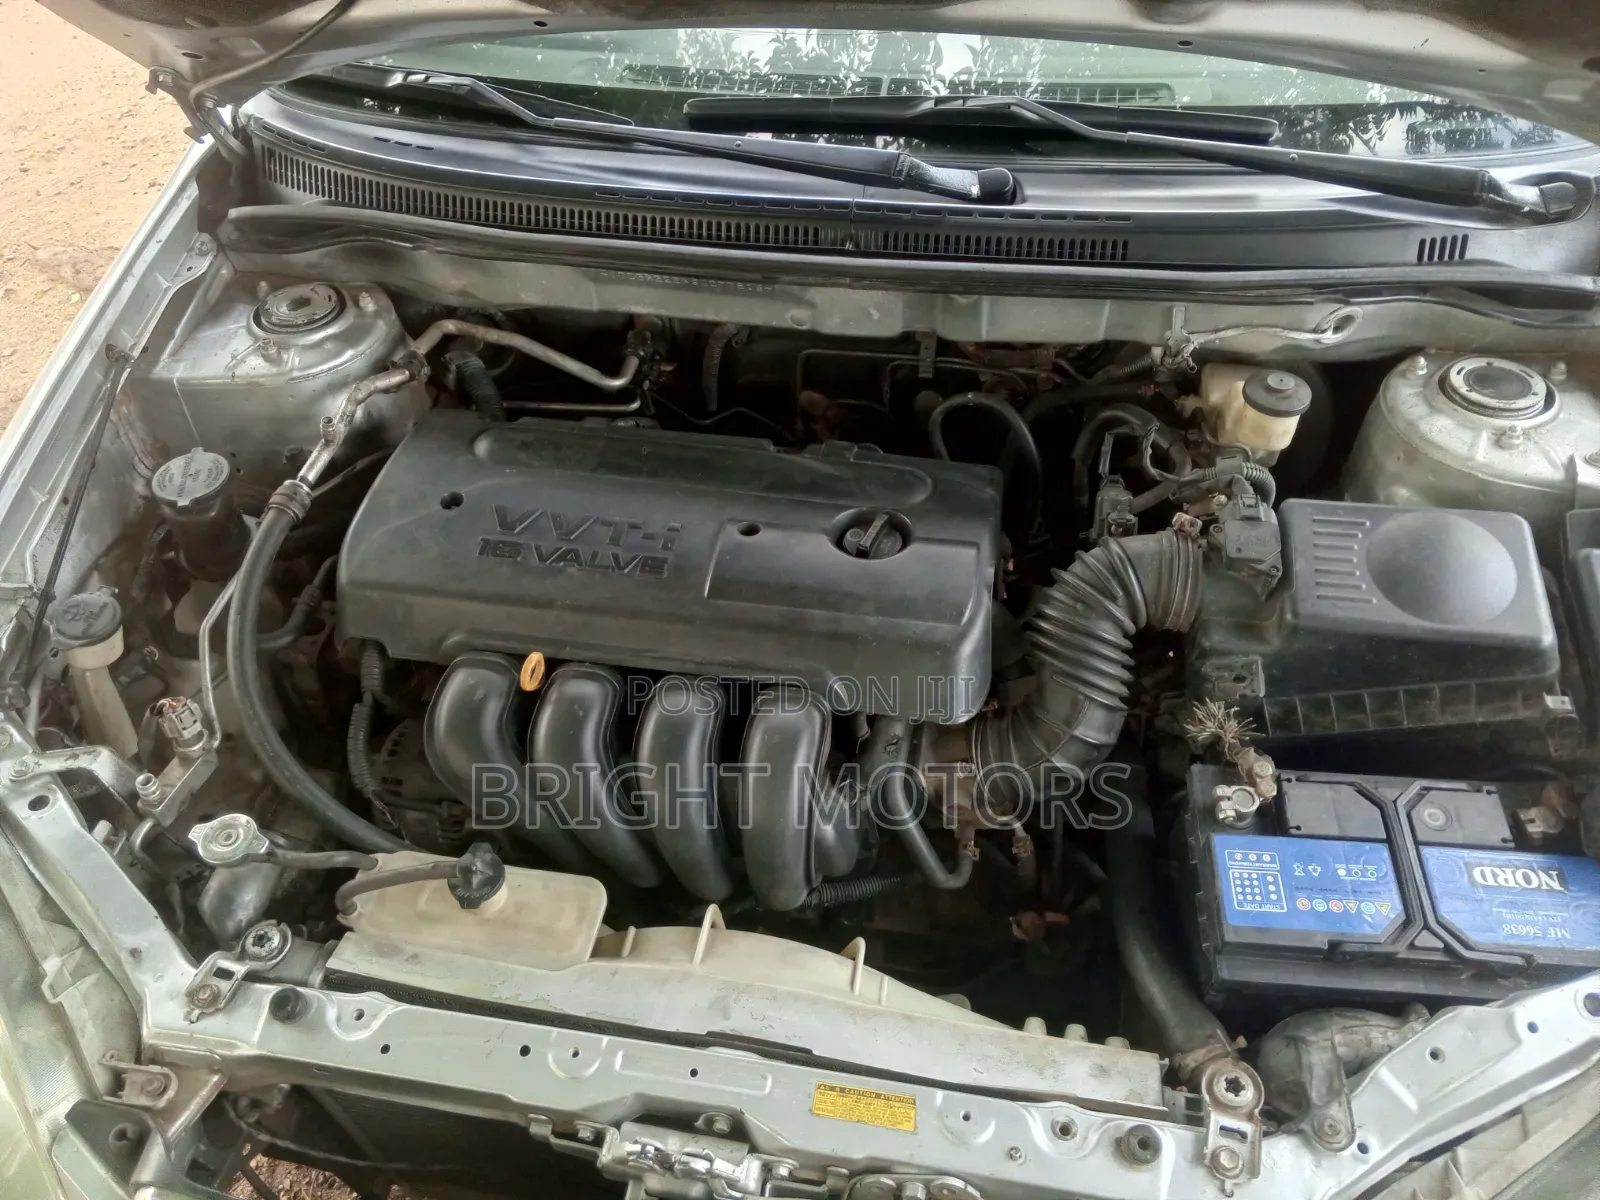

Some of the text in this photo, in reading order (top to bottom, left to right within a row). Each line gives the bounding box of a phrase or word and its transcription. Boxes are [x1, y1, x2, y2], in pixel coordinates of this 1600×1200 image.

[492, 503, 683, 550] VVT-i
[532, 542, 672, 578] VALVE
[1472, 866, 1569, 893] NORD
[1503, 923, 1571, 939] MF 56638
[845, 1088, 876, 1098] CAUTION
[880, 1094, 915, 1104] ATTENTION
